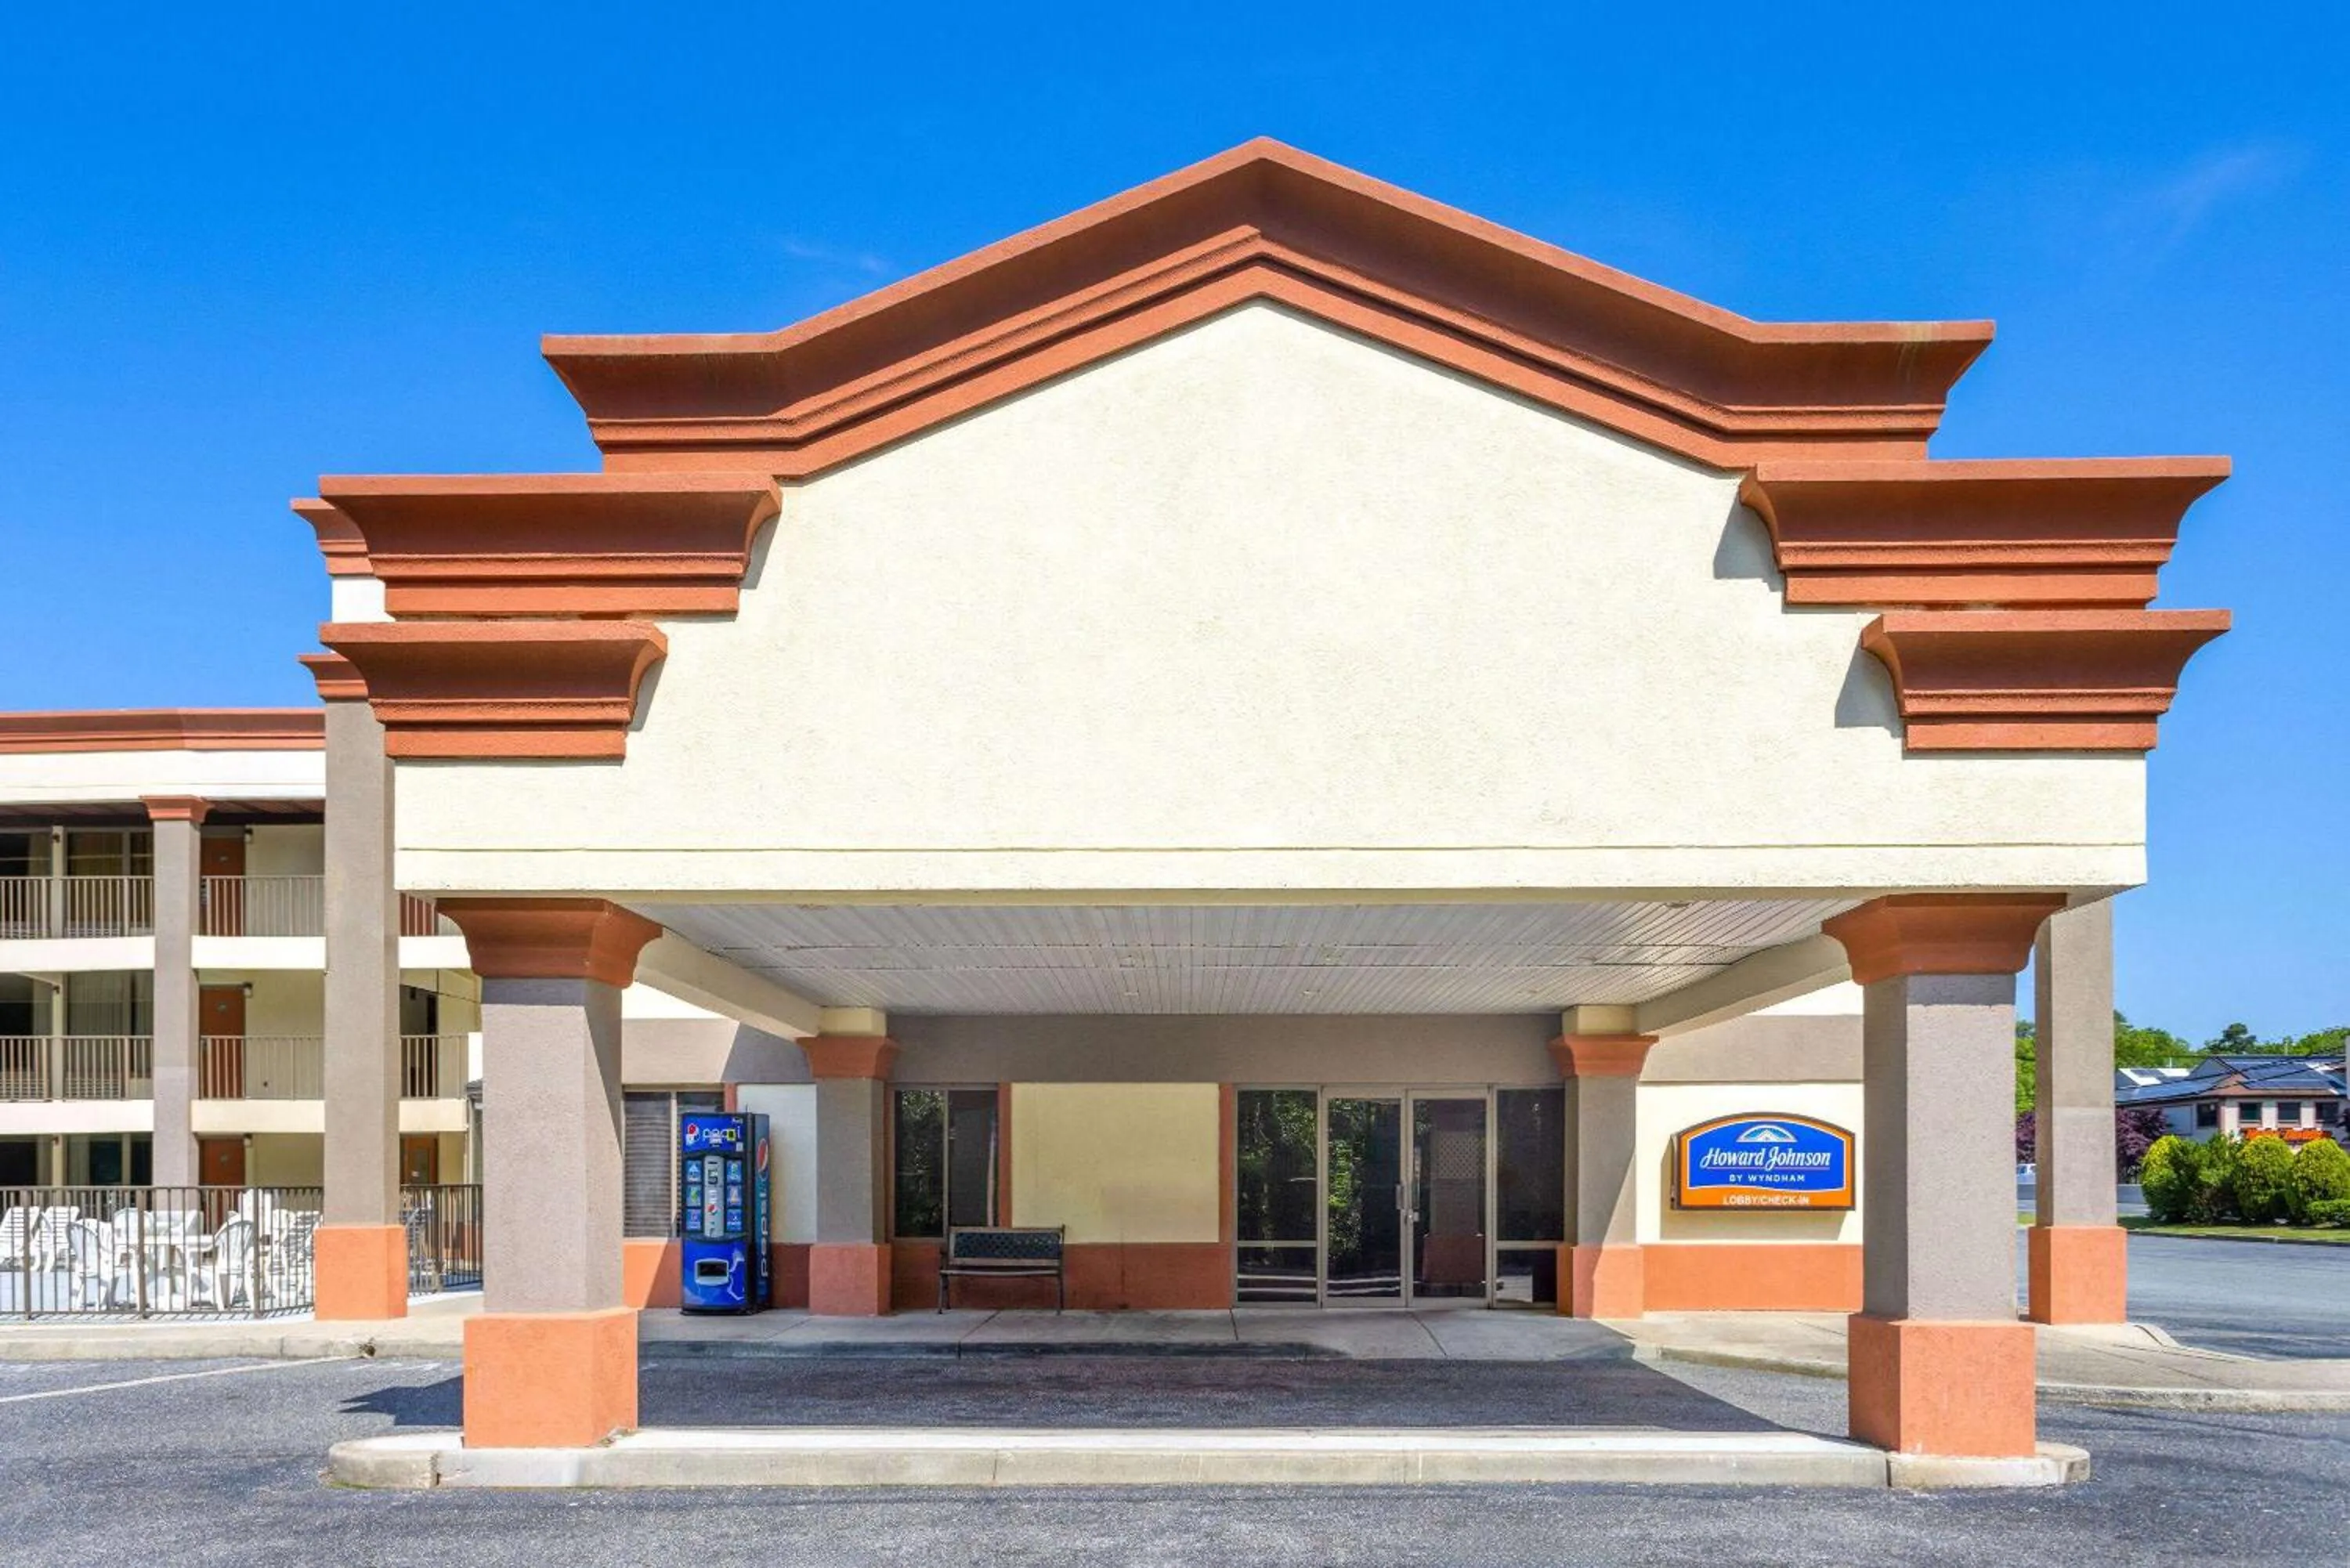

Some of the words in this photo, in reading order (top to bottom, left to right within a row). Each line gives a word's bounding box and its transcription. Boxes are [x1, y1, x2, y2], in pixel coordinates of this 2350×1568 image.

[702, 1125, 741, 1142] pepi
[1700, 1147, 1764, 1168] Howard
[1764, 1147, 1831, 1171] Johnson
